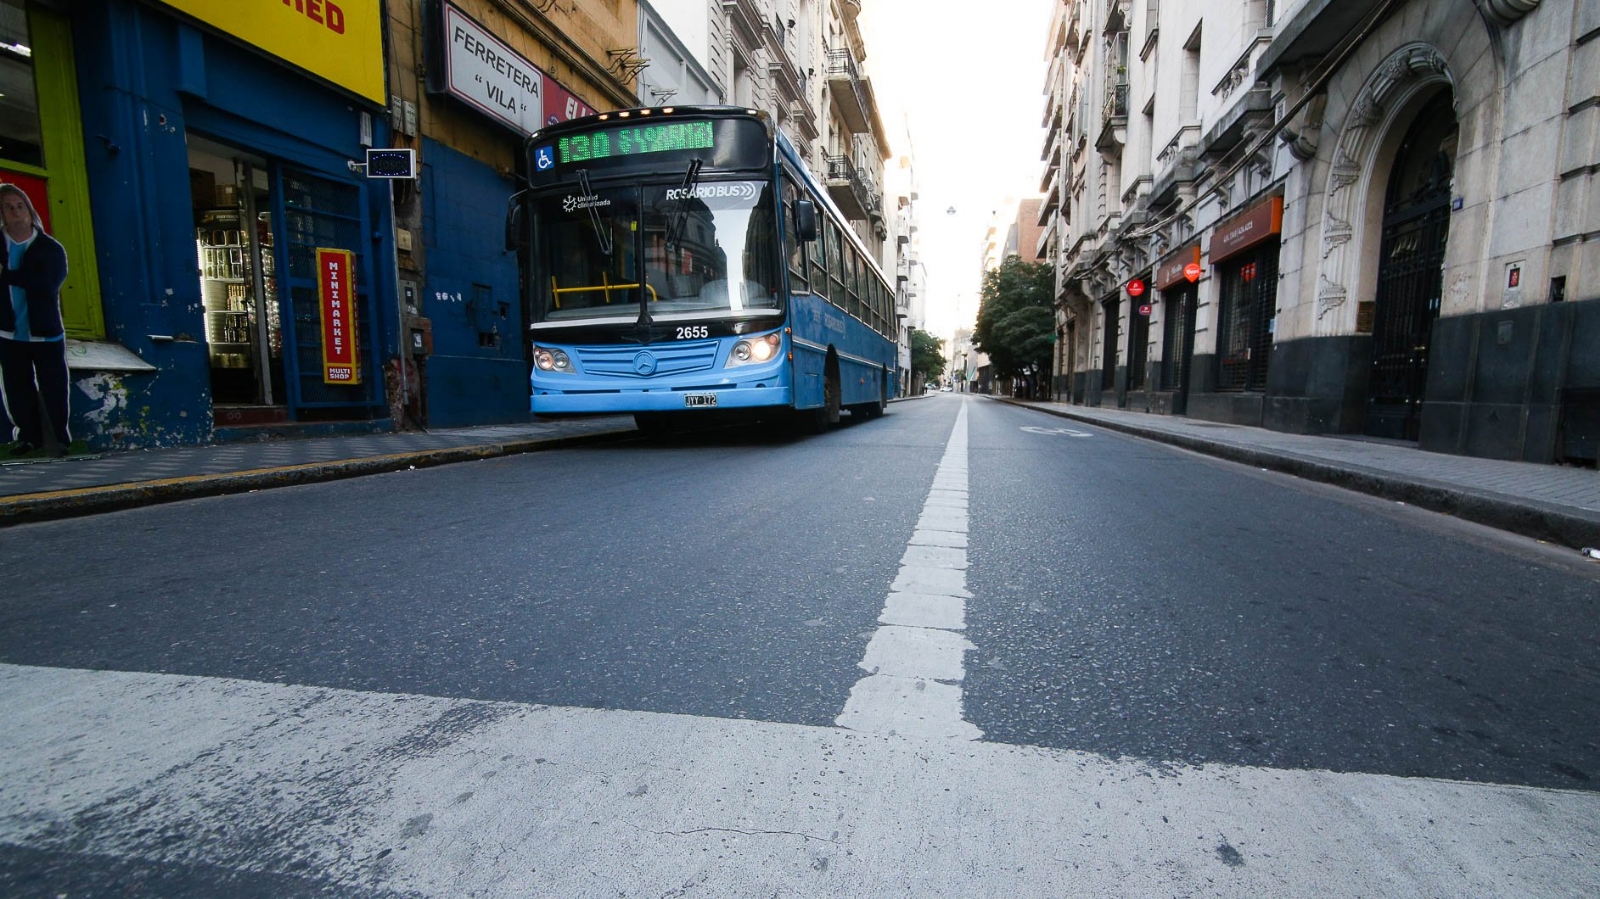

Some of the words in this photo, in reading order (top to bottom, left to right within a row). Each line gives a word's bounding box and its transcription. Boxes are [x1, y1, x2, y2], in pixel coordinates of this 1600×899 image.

[454, 26, 539, 98] FERRETERA
[716, 185, 740, 197] BUS
[329, 262, 342, 354] MINIMARKET
[676, 326, 708, 339] 2655
